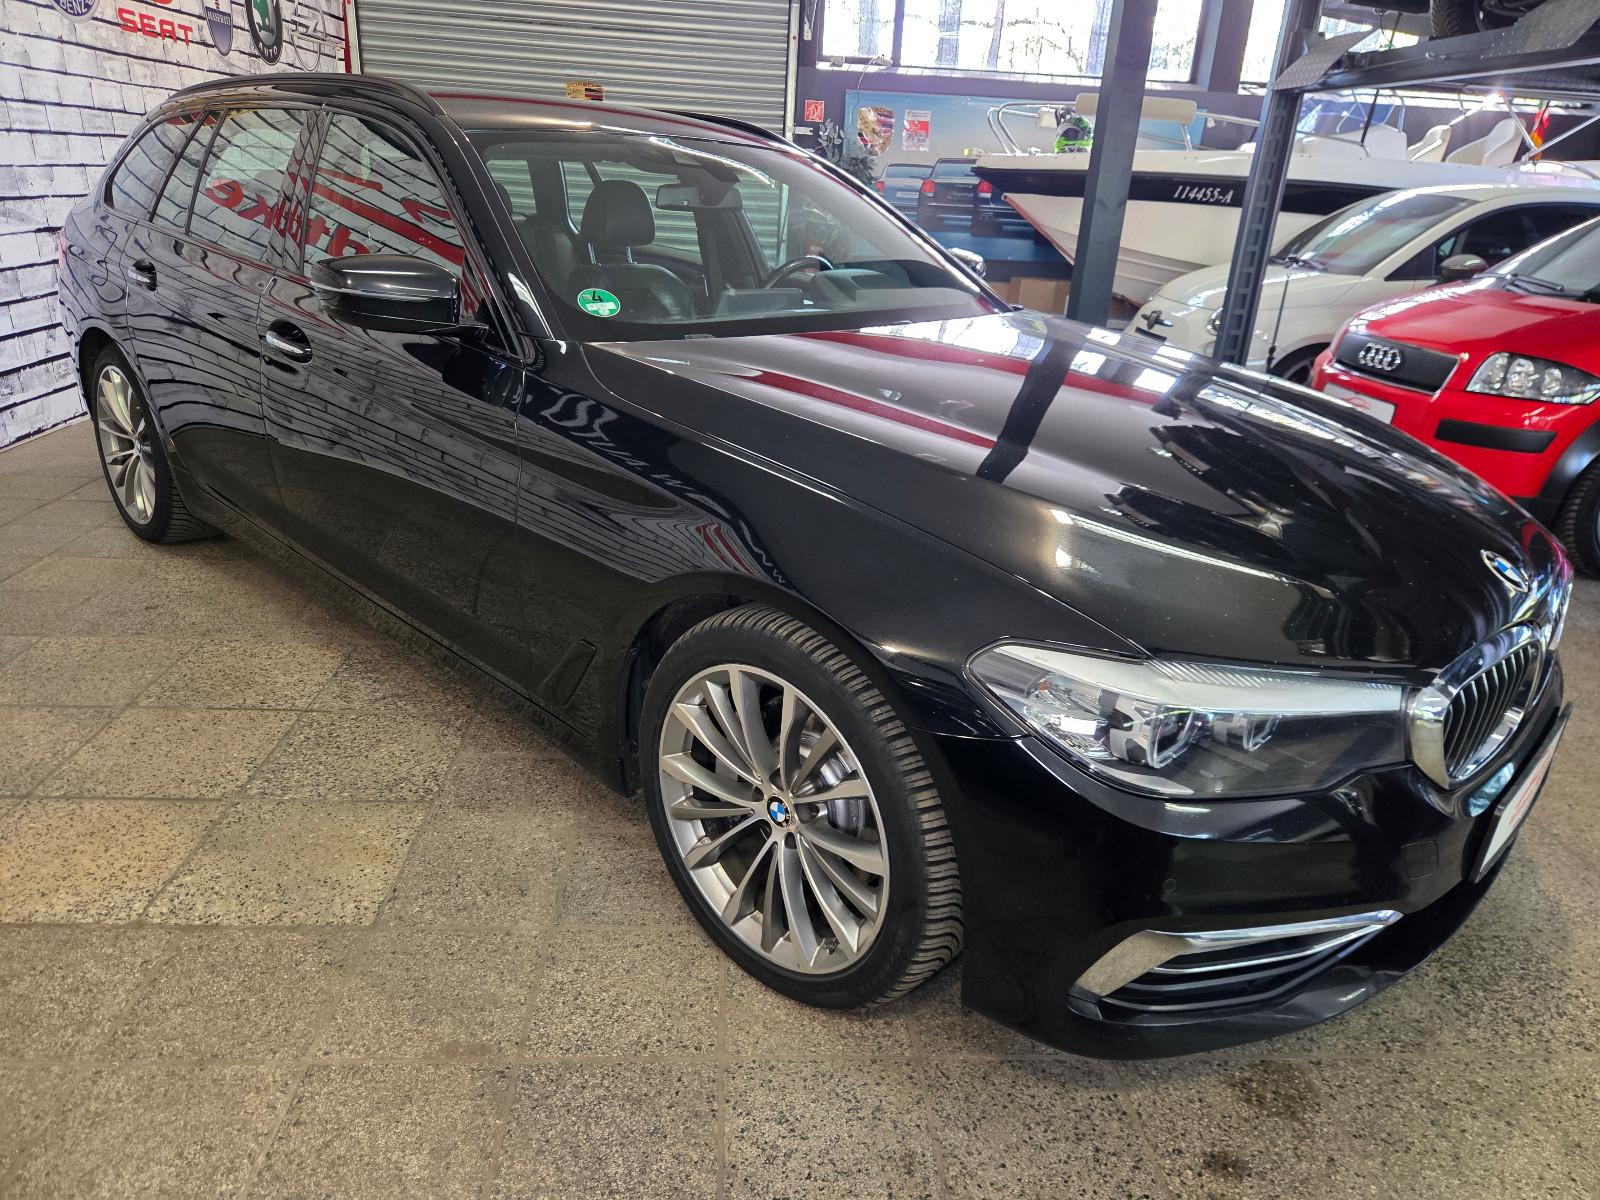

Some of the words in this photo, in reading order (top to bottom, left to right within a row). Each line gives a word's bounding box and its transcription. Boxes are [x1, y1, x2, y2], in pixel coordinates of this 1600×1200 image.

[59, 0, 88, 15] BENZ
[118, 7, 193, 46] SEAT
[259, 42, 278, 58] AUTO
[1173, 185, 1234, 204] 114455-A
[592, 290, 604, 303] 4
